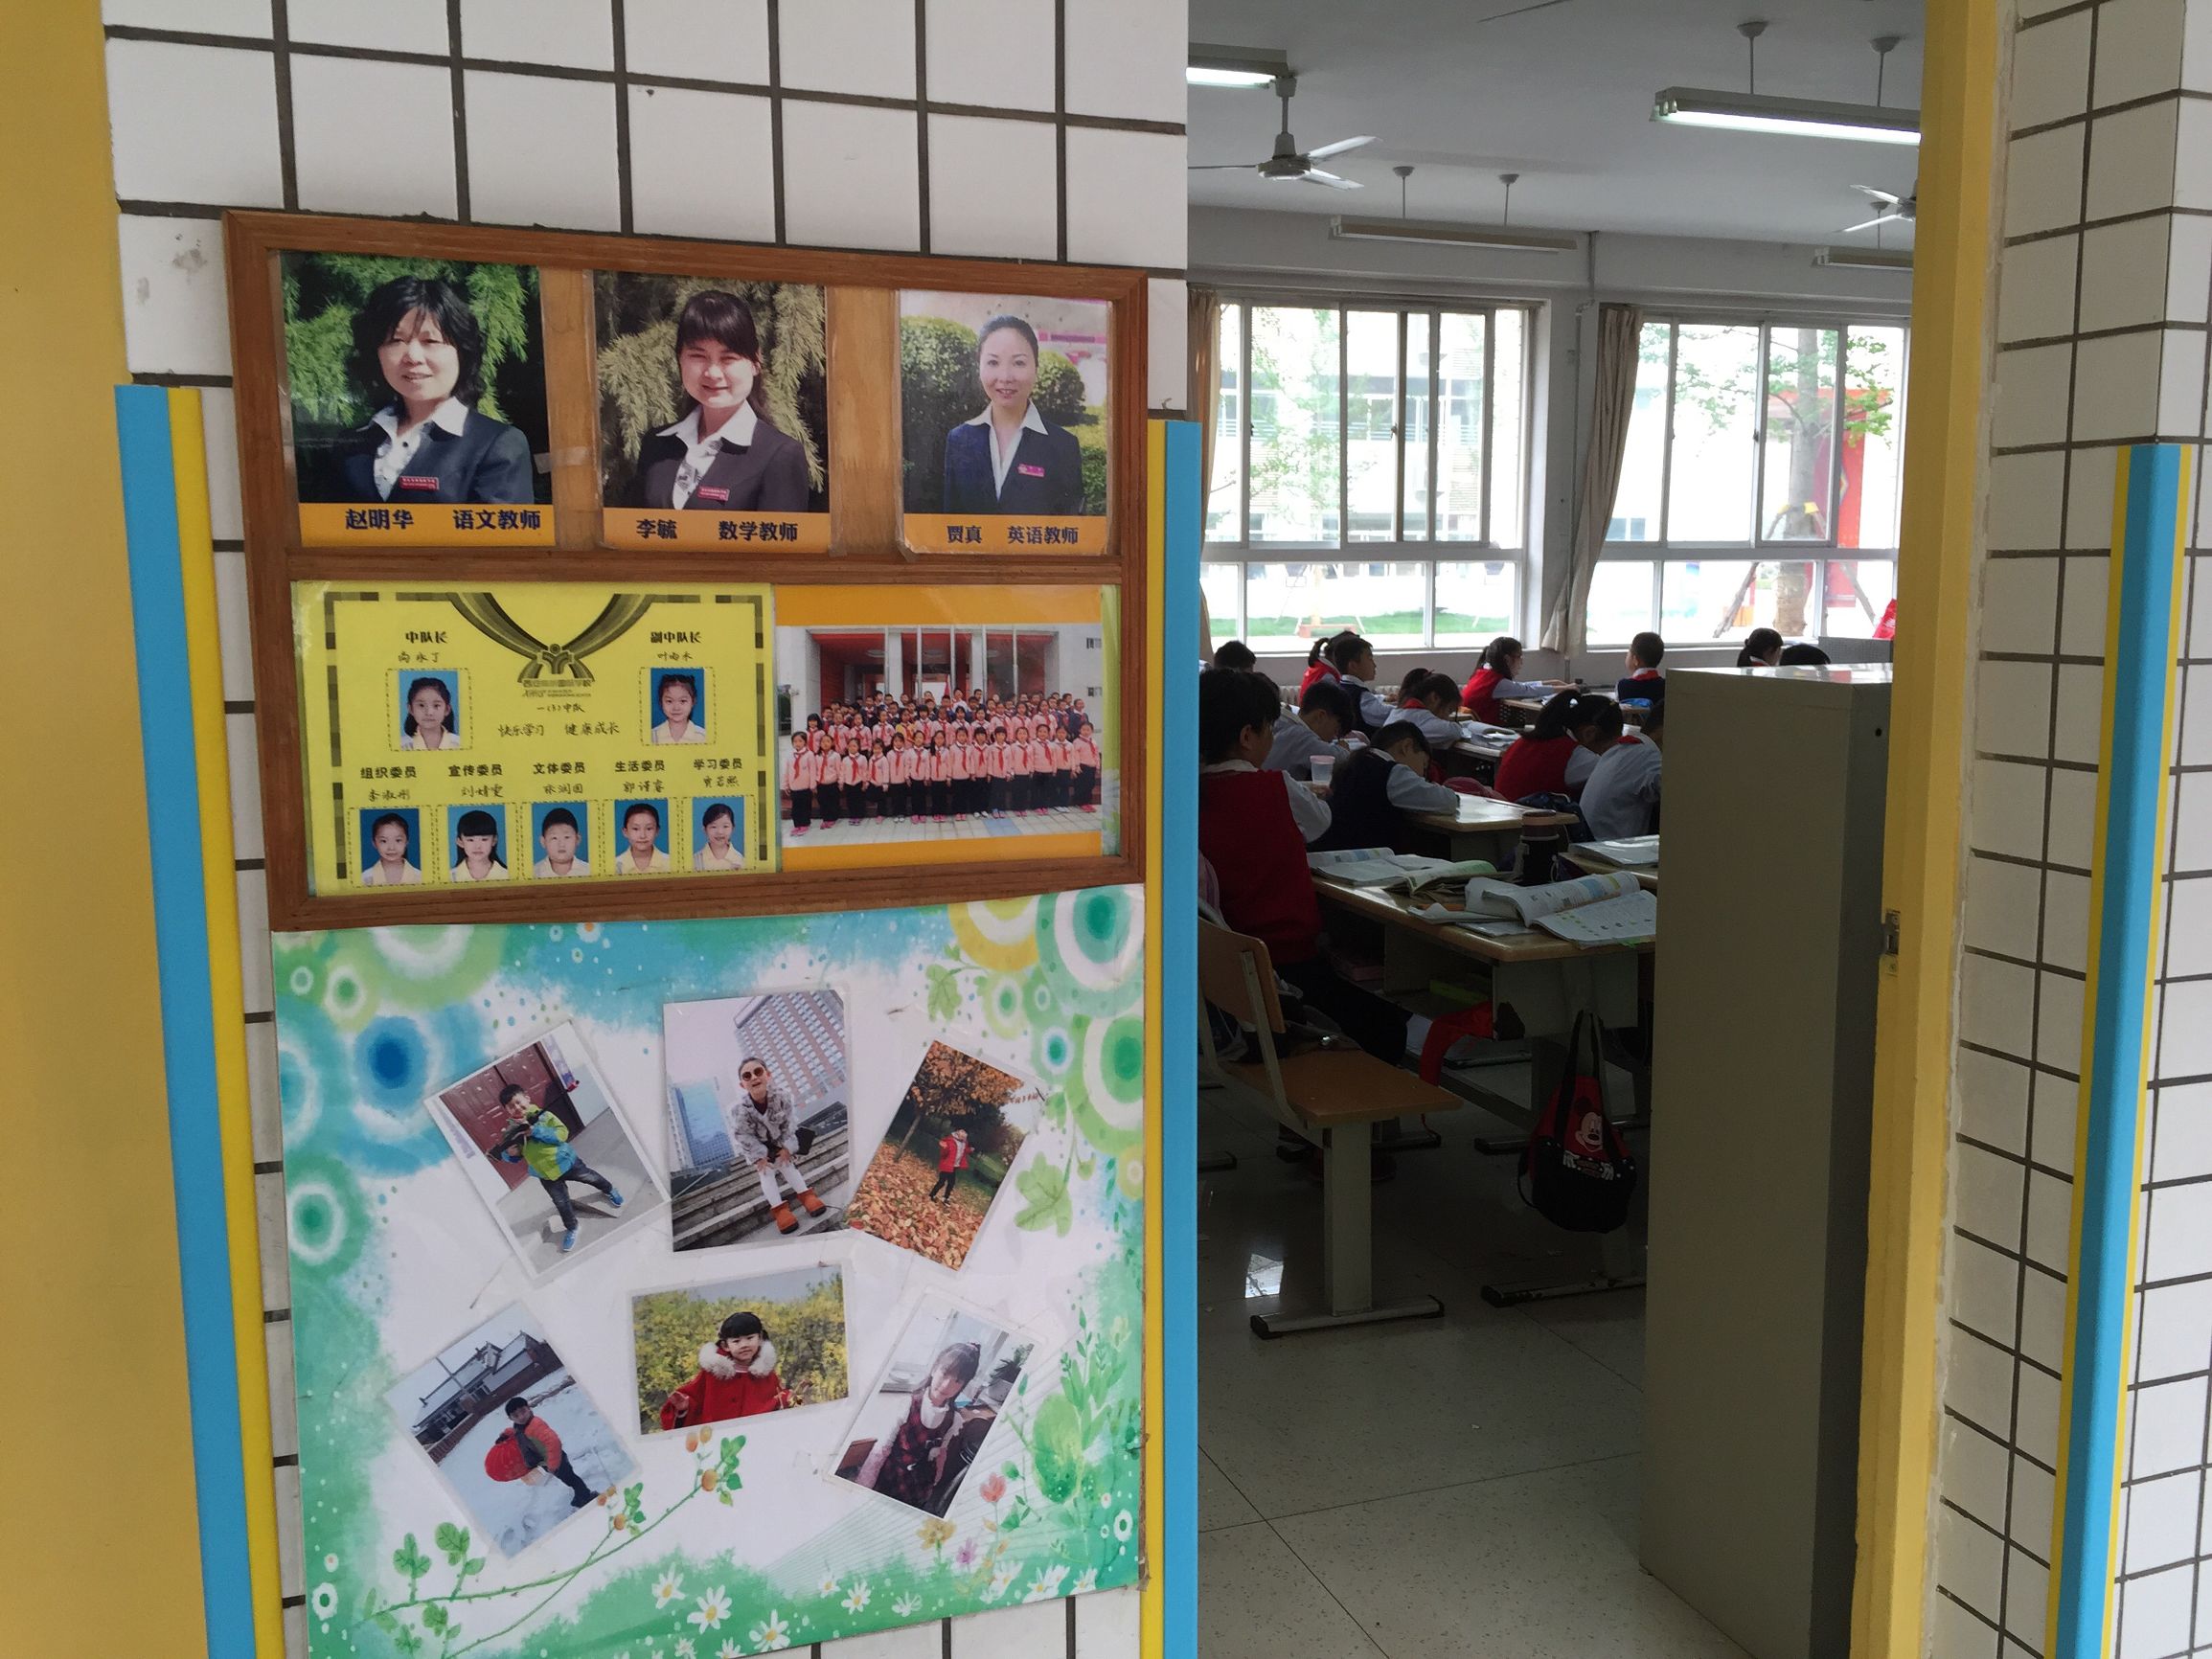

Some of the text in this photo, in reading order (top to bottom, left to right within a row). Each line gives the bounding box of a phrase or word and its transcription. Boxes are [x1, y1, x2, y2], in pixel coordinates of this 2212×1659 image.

[345, 509, 541, 531] 赵明华 语文教师
[636, 518, 799, 542] 李毓 数学教师
[946, 525, 1079, 545] 贾真 英语教师
[405, 630, 448, 644] 中队长
[650, 630, 701, 644] 副中队长
[448, 763, 503, 777] 宣传委员
[533, 761, 585, 775] 文体委员
[614, 760, 666, 773] 生活委员
[693, 758, 743, 770] 学习委员
[360, 765, 418, 779] 组织委员
